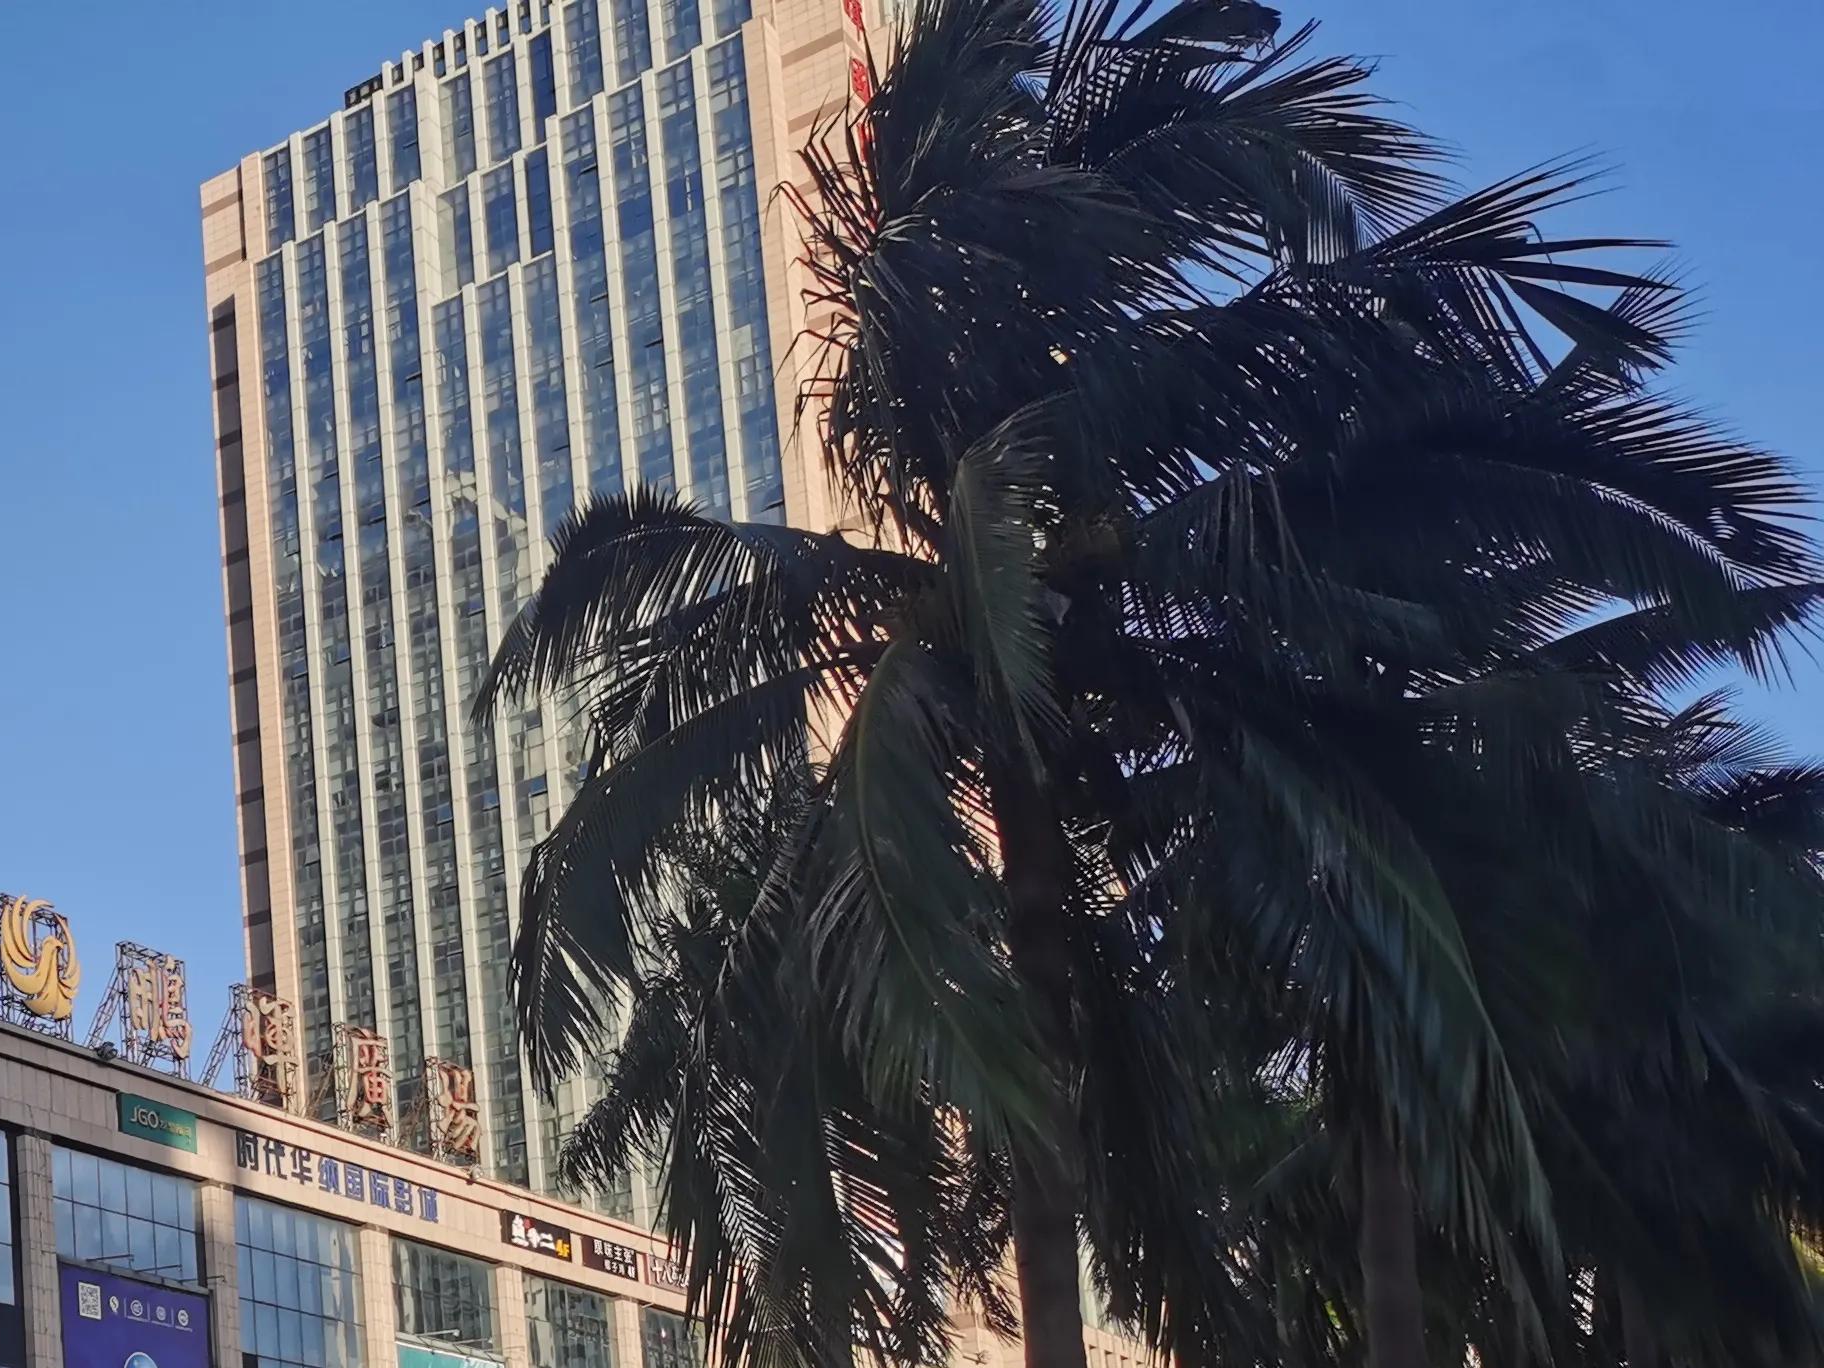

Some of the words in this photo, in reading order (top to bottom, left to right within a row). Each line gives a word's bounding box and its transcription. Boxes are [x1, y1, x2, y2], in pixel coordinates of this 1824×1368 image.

[130, 1105, 159, 1129] JGO
[236, 1129, 439, 1223] 时代华纳国际影城
